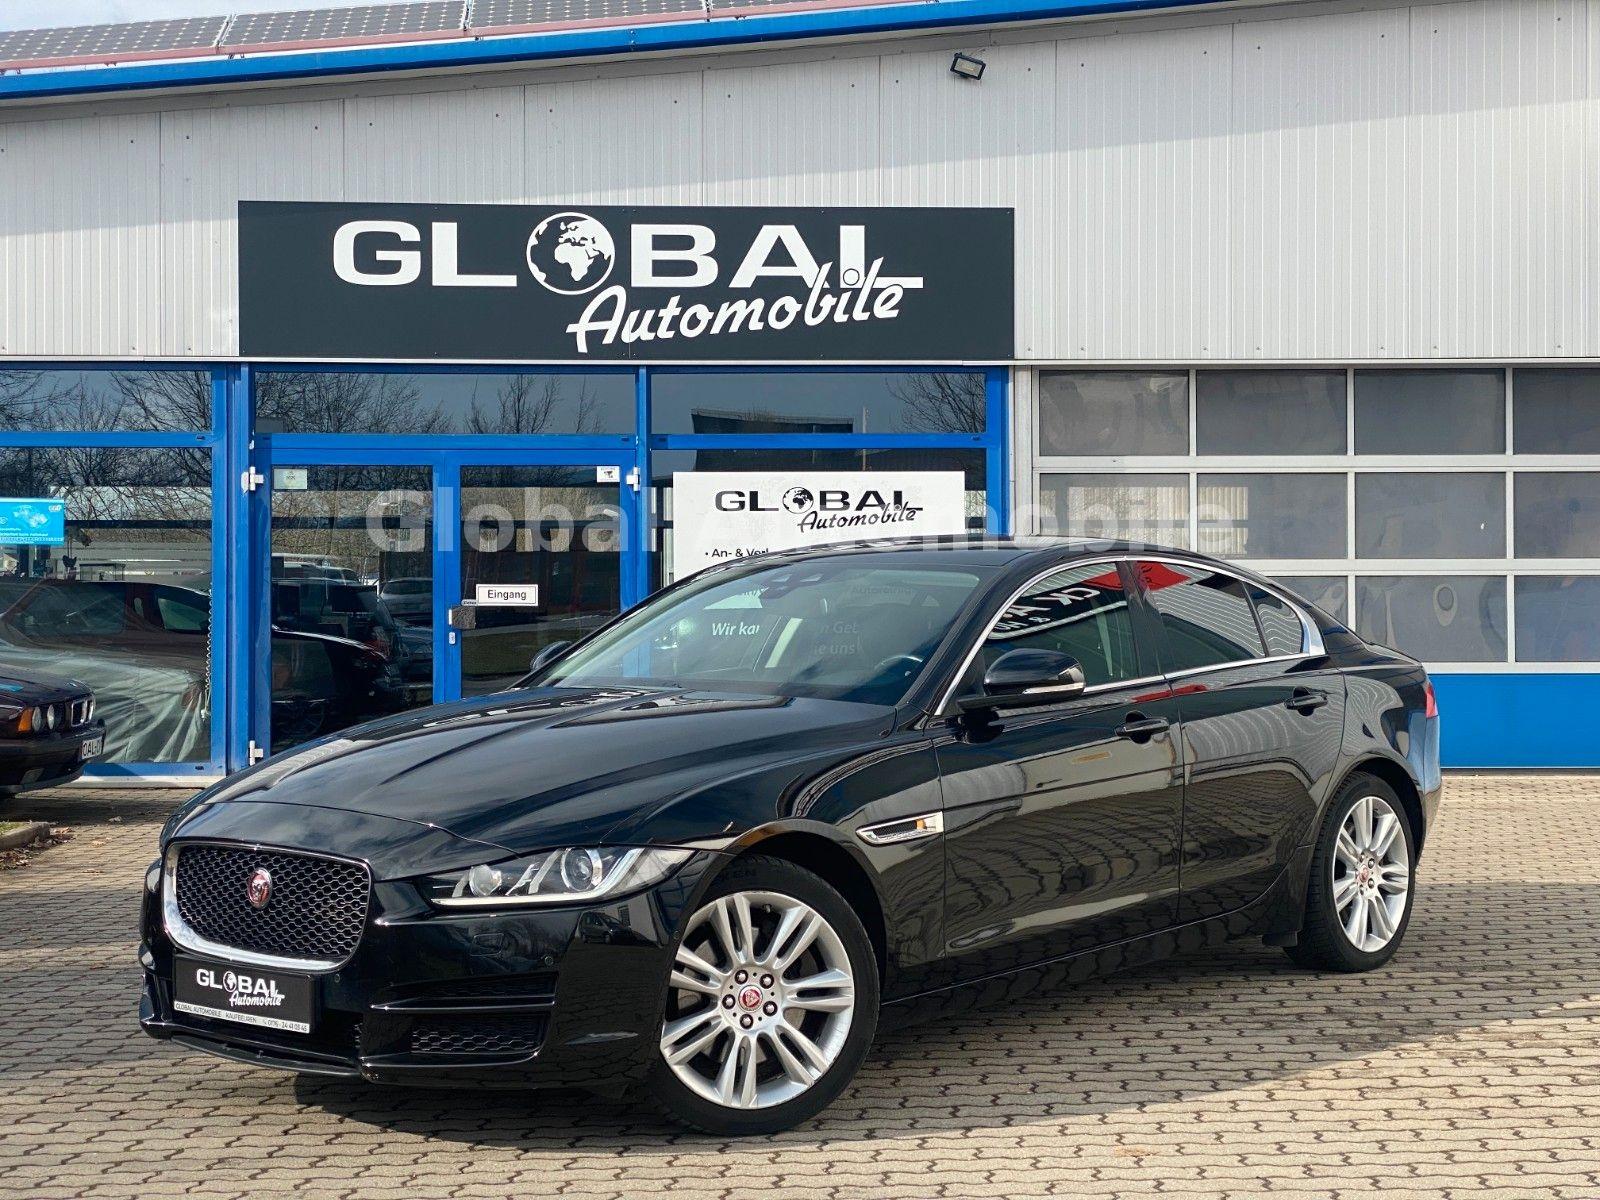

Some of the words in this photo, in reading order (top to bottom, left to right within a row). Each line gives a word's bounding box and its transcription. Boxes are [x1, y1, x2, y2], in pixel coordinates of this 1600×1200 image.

[333, 212, 923, 294] GLOBAL
[566, 257, 903, 352] Automobile
[715, 487, 923, 514] GLOBAL
[797, 501, 917, 533] Automobile
[487, 589, 527, 601] Eingang
[712, 621, 734, 636] Wir
[196, 968, 285, 999] GLOBAL
[229, 990, 282, 1006] Automobile
